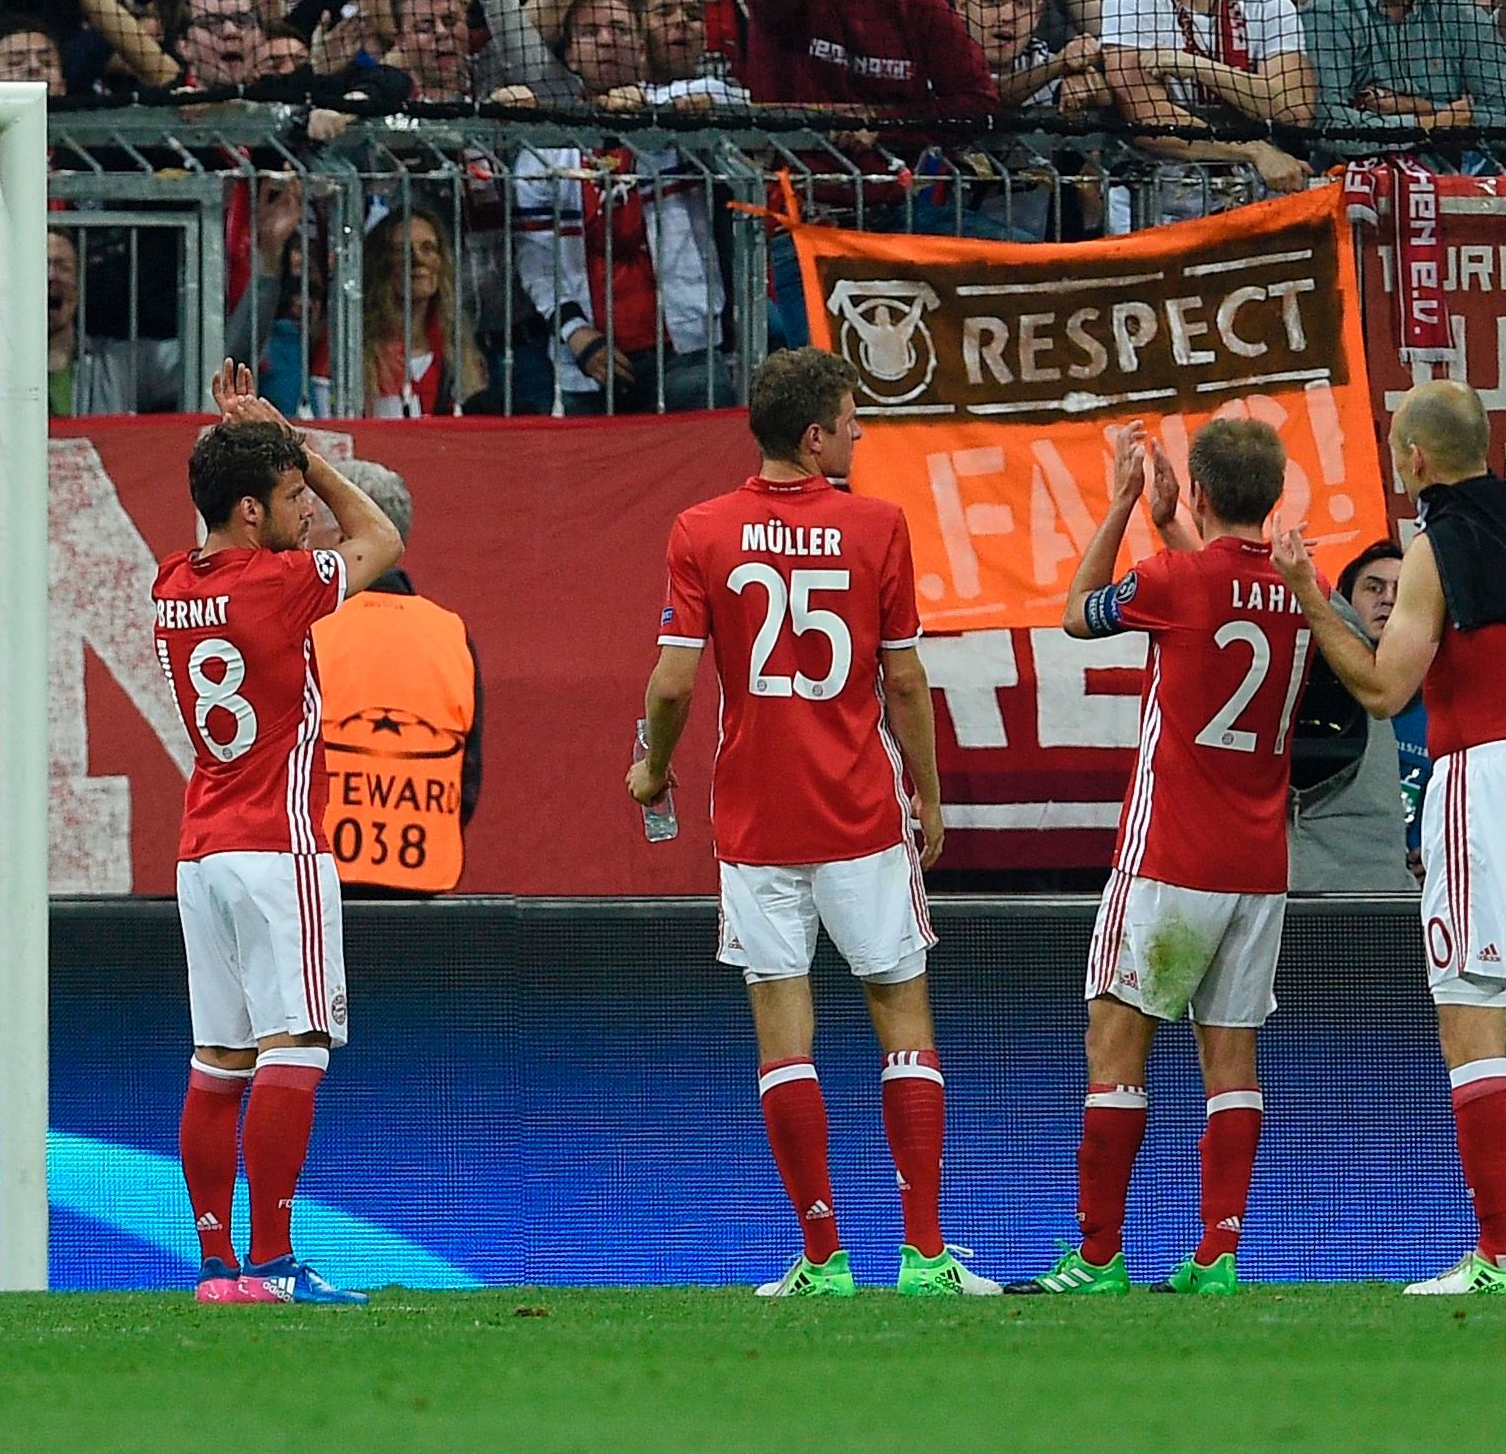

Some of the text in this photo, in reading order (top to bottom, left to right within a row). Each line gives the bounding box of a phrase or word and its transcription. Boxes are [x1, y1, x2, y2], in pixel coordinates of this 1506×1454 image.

[962, 278, 1316, 386] RESPECT
[741, 519, 842, 557] MÜLLER
[157, 595, 230, 629] BERNAT
[726, 562, 852, 701] 25
[1195, 619, 1312, 755] 21
[332, 816, 427, 870] 038
